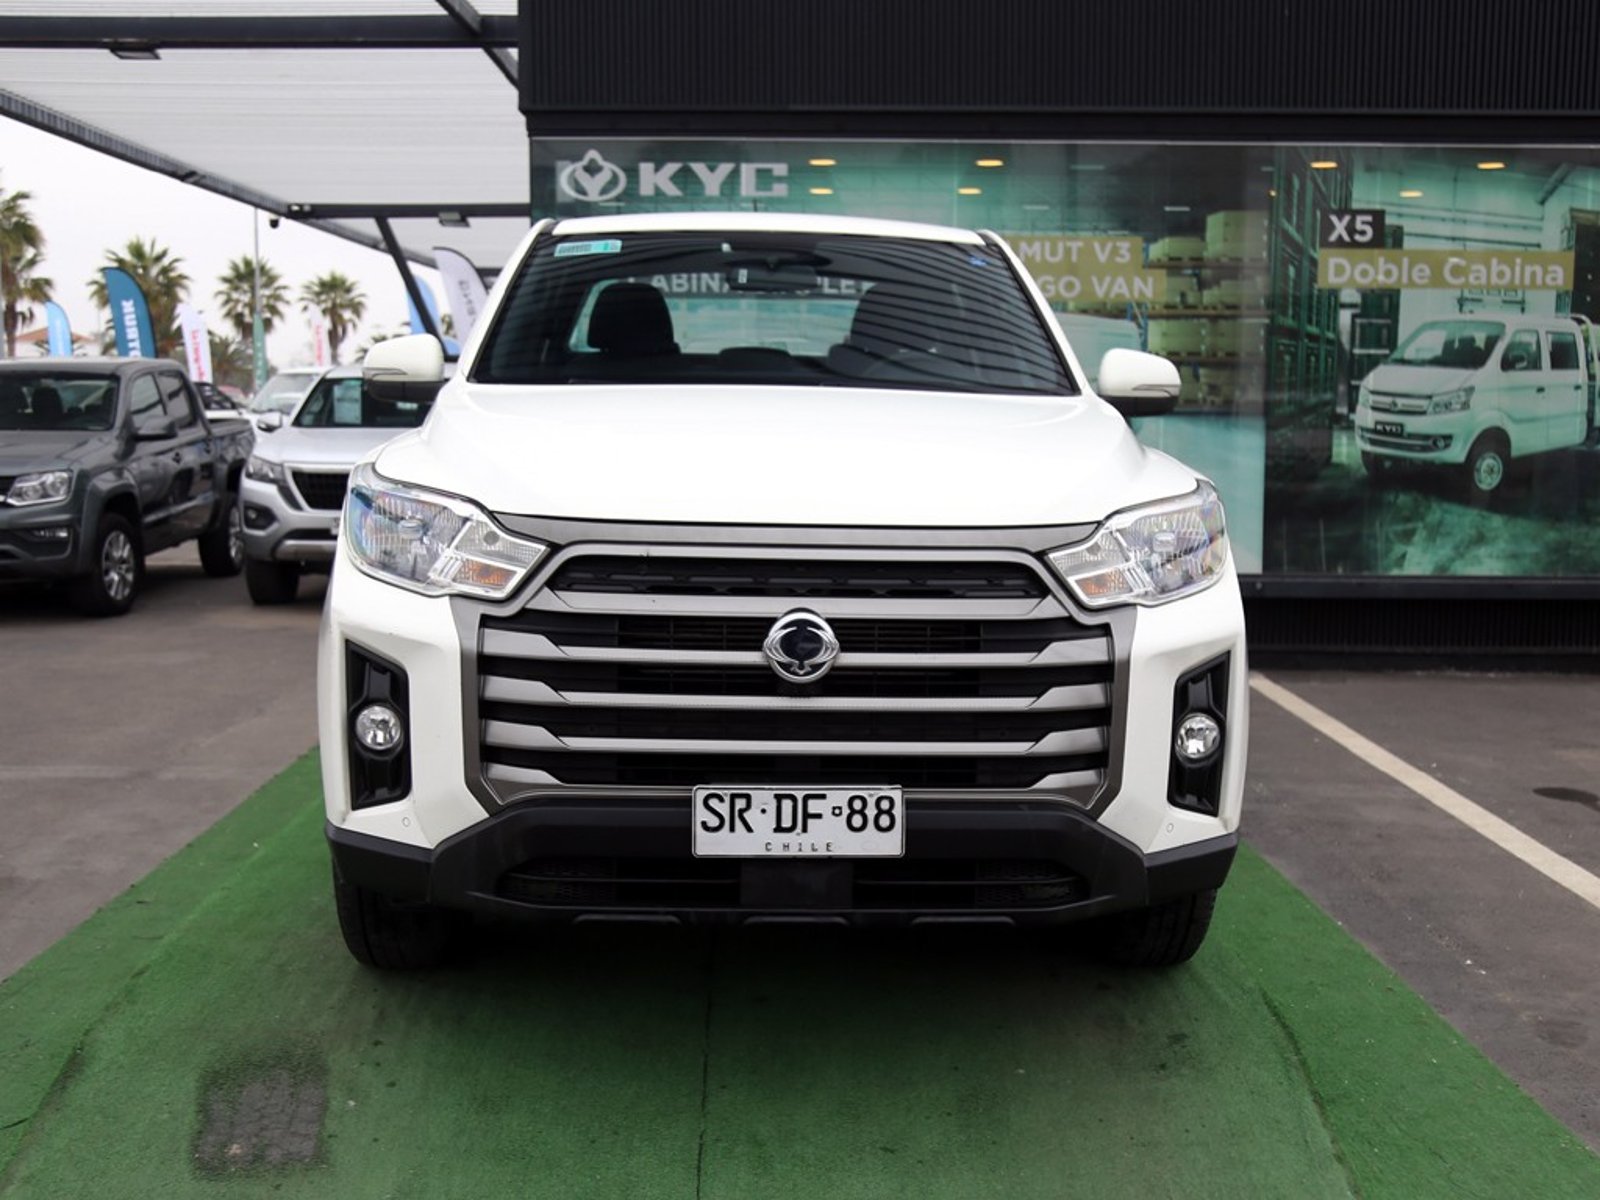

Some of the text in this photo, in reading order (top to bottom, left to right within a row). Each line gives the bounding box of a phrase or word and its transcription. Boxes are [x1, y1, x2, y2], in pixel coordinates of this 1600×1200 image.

[639, 162, 788, 197] KYC
[1328, 214, 1373, 242] X5
[1093, 241, 1131, 263] V3
[1327, 257, 1564, 286] Doble Cabina
[1091, 276, 1153, 299] VAN
[764, 841, 833, 852] CHILE
